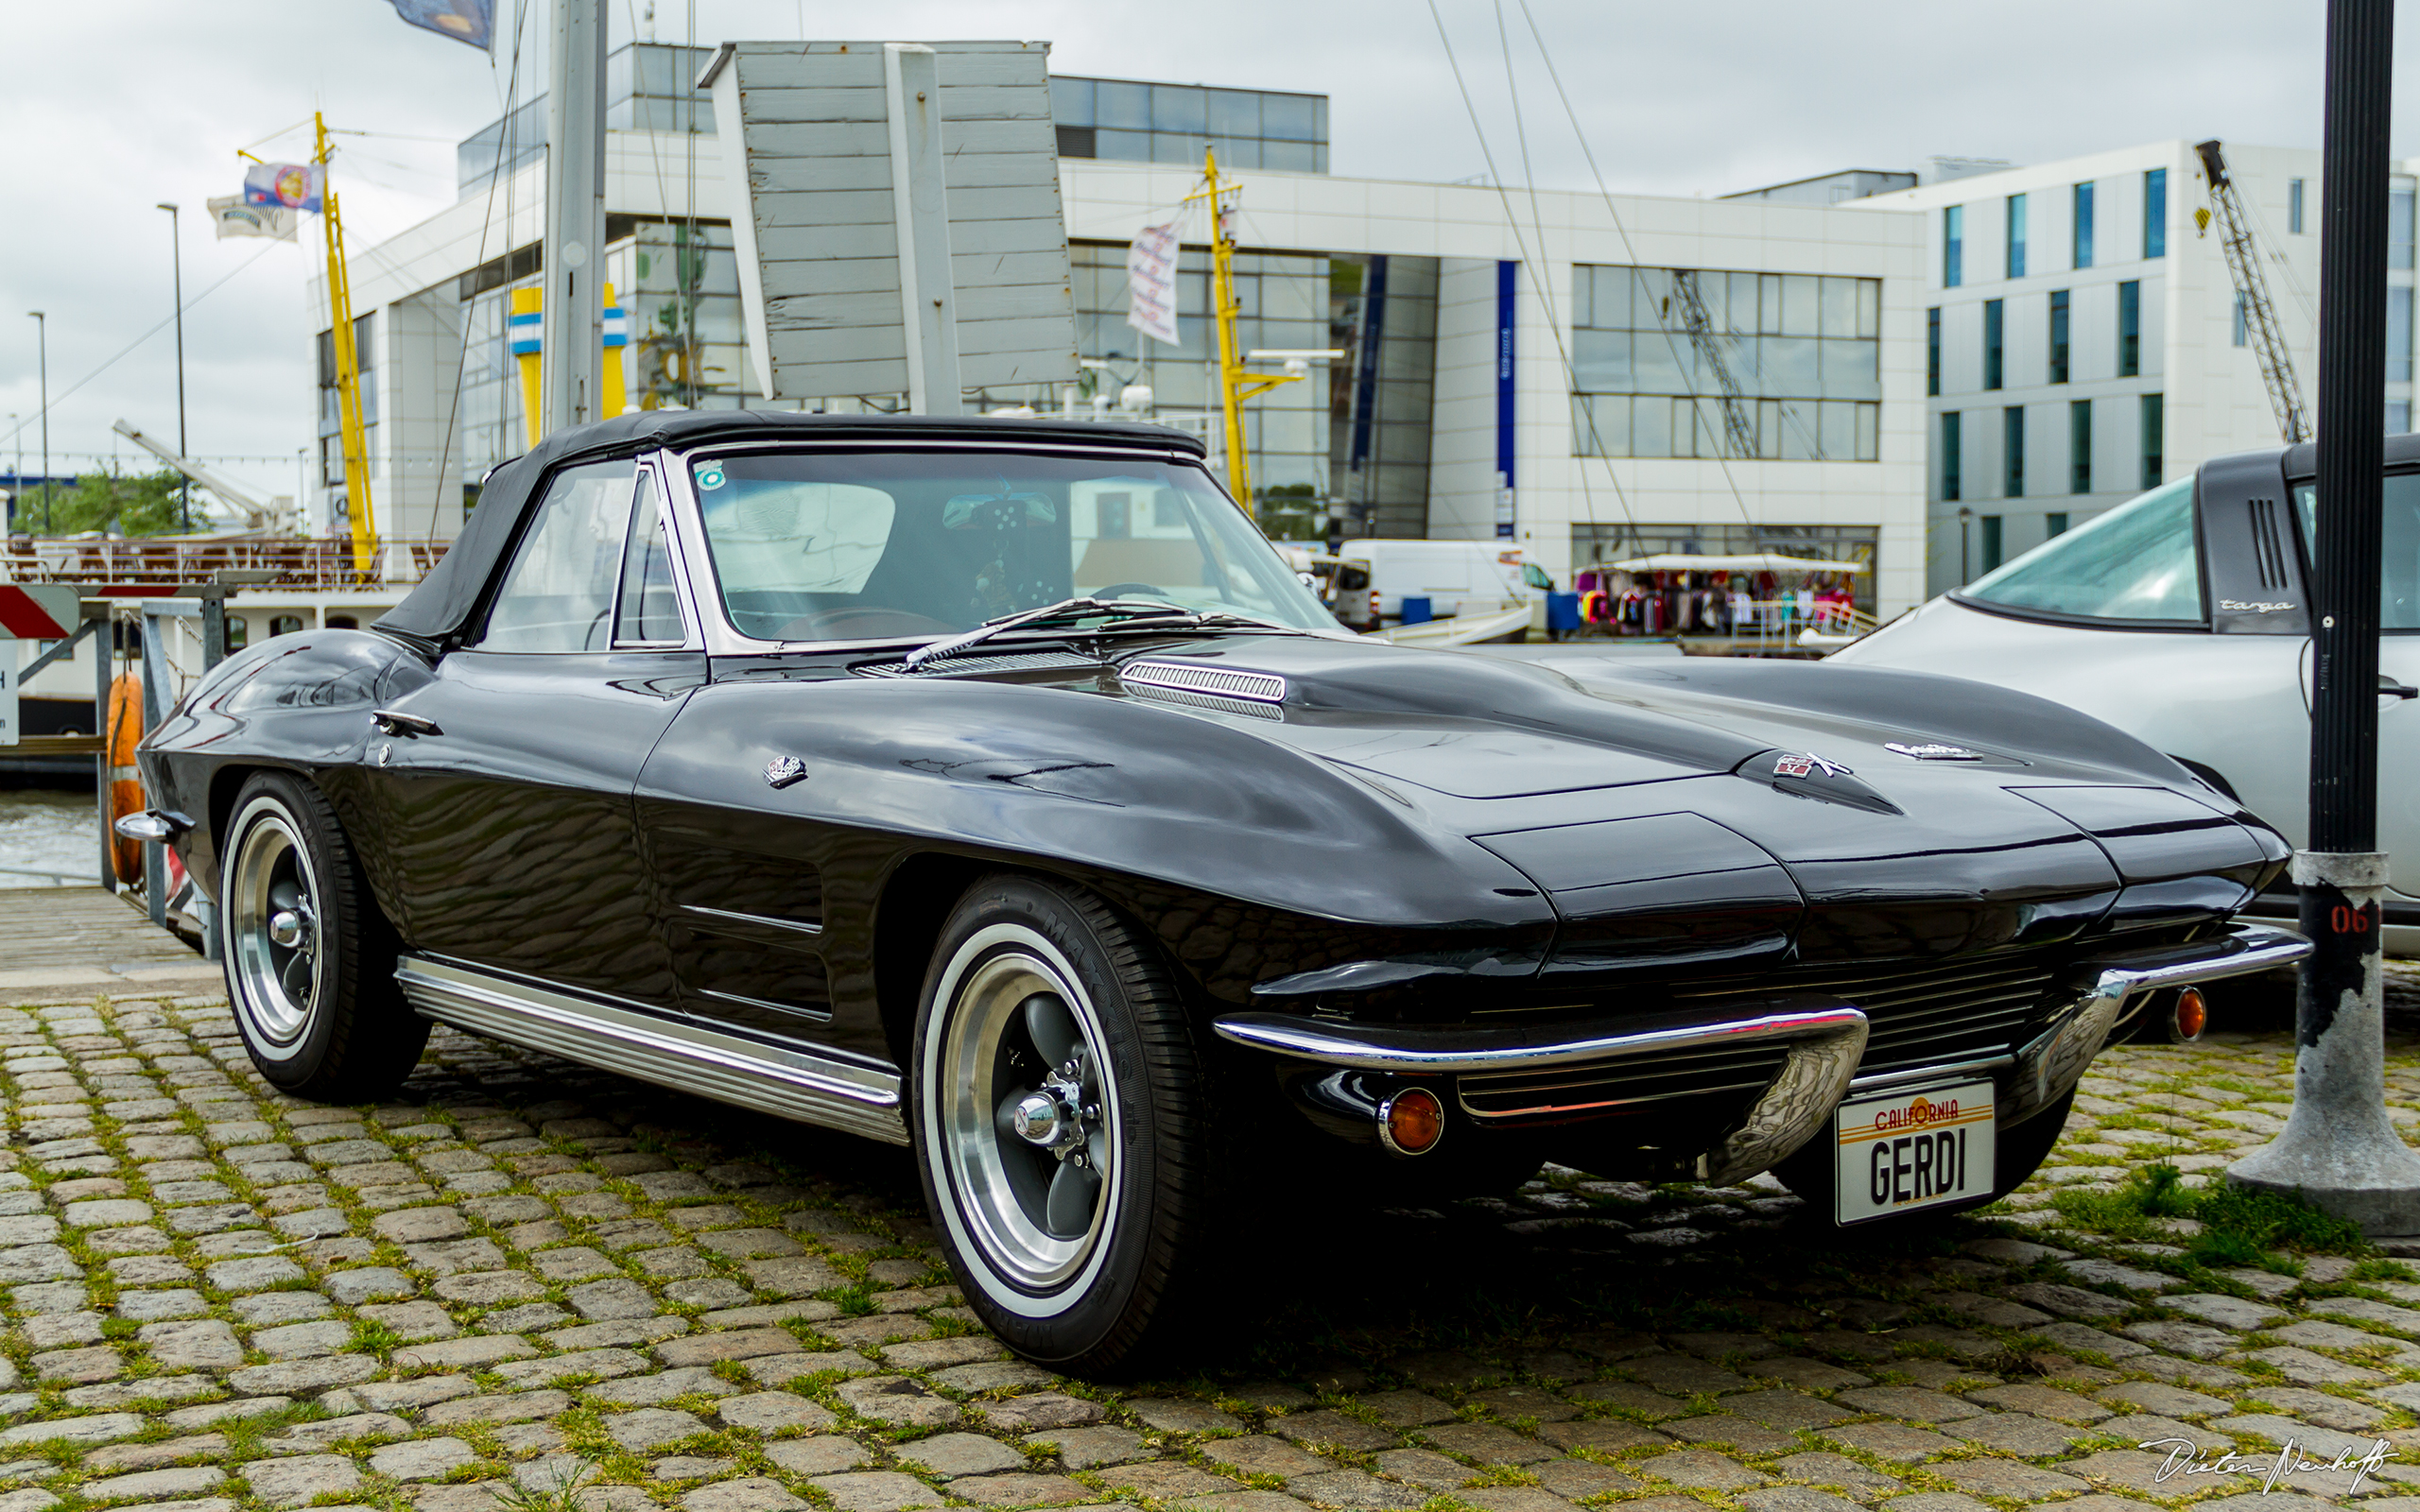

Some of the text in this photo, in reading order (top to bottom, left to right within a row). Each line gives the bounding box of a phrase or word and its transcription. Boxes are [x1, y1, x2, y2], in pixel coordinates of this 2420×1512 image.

[2219, 598, 2297, 613] targa
[2331, 904, 2381, 934] 06
[1043, 911, 1132, 1080] MAXXIS
[1875, 1099, 1959, 1131] CALIFORNIA
[1871, 1127, 1966, 1206] GERDI
